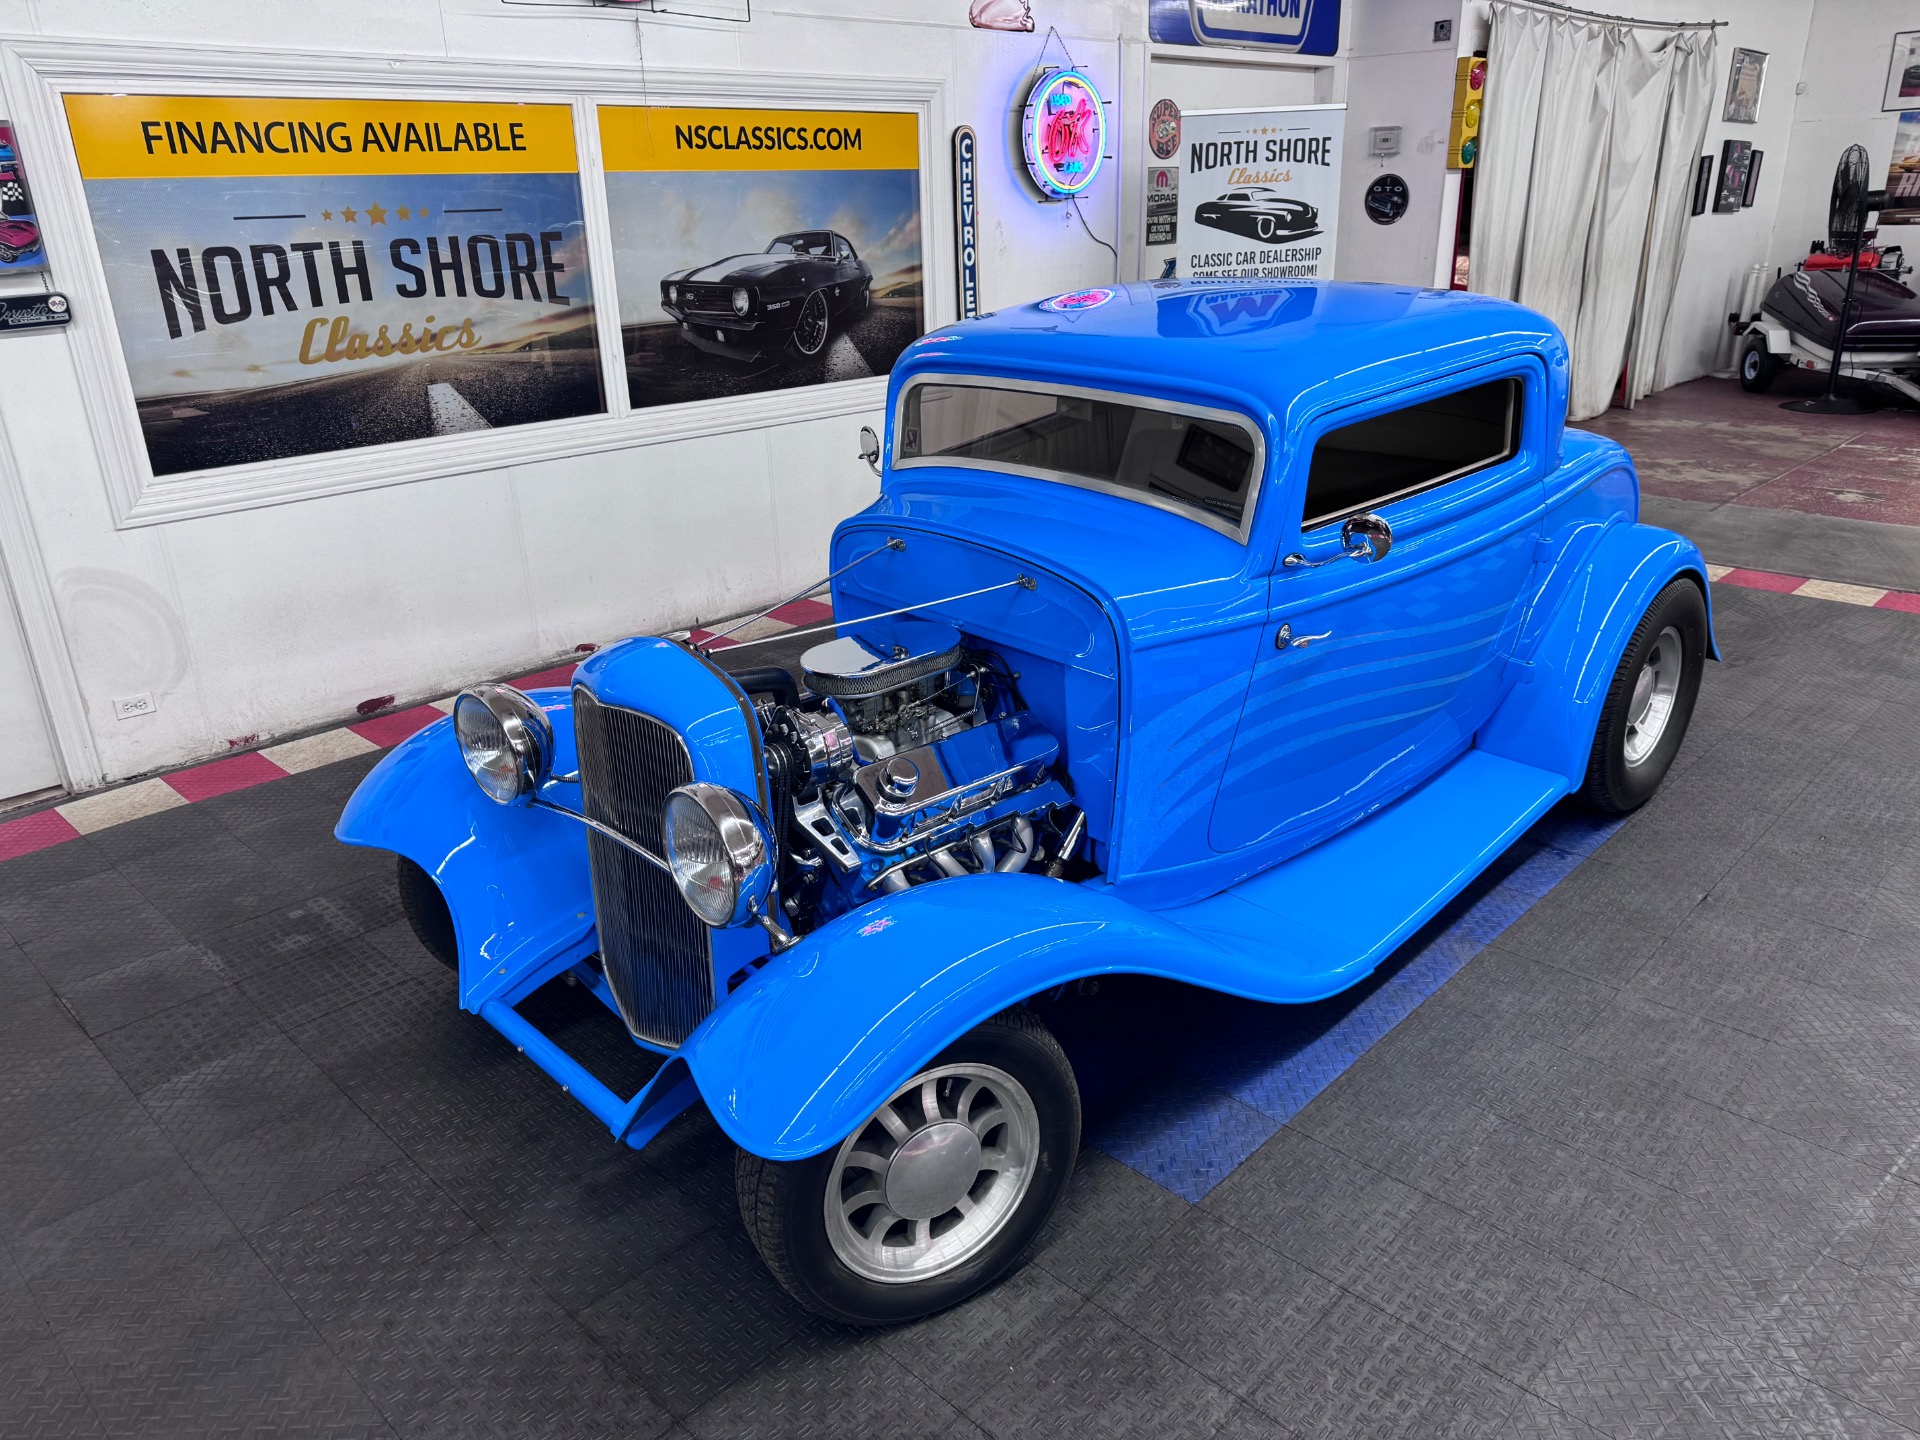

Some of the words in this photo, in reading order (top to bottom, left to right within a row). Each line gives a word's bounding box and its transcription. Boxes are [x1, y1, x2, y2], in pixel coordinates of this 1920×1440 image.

[1151, 101, 1179, 134] SUPER
[141, 121, 352, 154] FINANCING
[362, 122, 527, 153] AVAILABLE
[675, 124, 862, 151] NSCLASSICS.COM
[1156, 135, 1177, 156] BEE
[1190, 140, 1258, 174] NORTH
[1265, 136, 1332, 167] SHORE
[1227, 167, 1293, 185] Classics
[1147, 193, 1177, 203] MOPAR
[961, 138, 977, 318] CHEVROLE
[1158, 214, 1171, 224] WITH
[1149, 232, 1167, 242] BEHIND
[1191, 252, 1233, 268] CLASSIC
[1235, 250, 1256, 265] CAR
[1259, 247, 1322, 264] DEALERSHIP
[1240, 267, 1259, 278] OUR
[1261, 264, 1318, 278] SHOWROOM!
[150, 240, 374, 340] NORTH
[390, 231, 570, 306] SHORE
[298, 315, 482, 365] Classics
